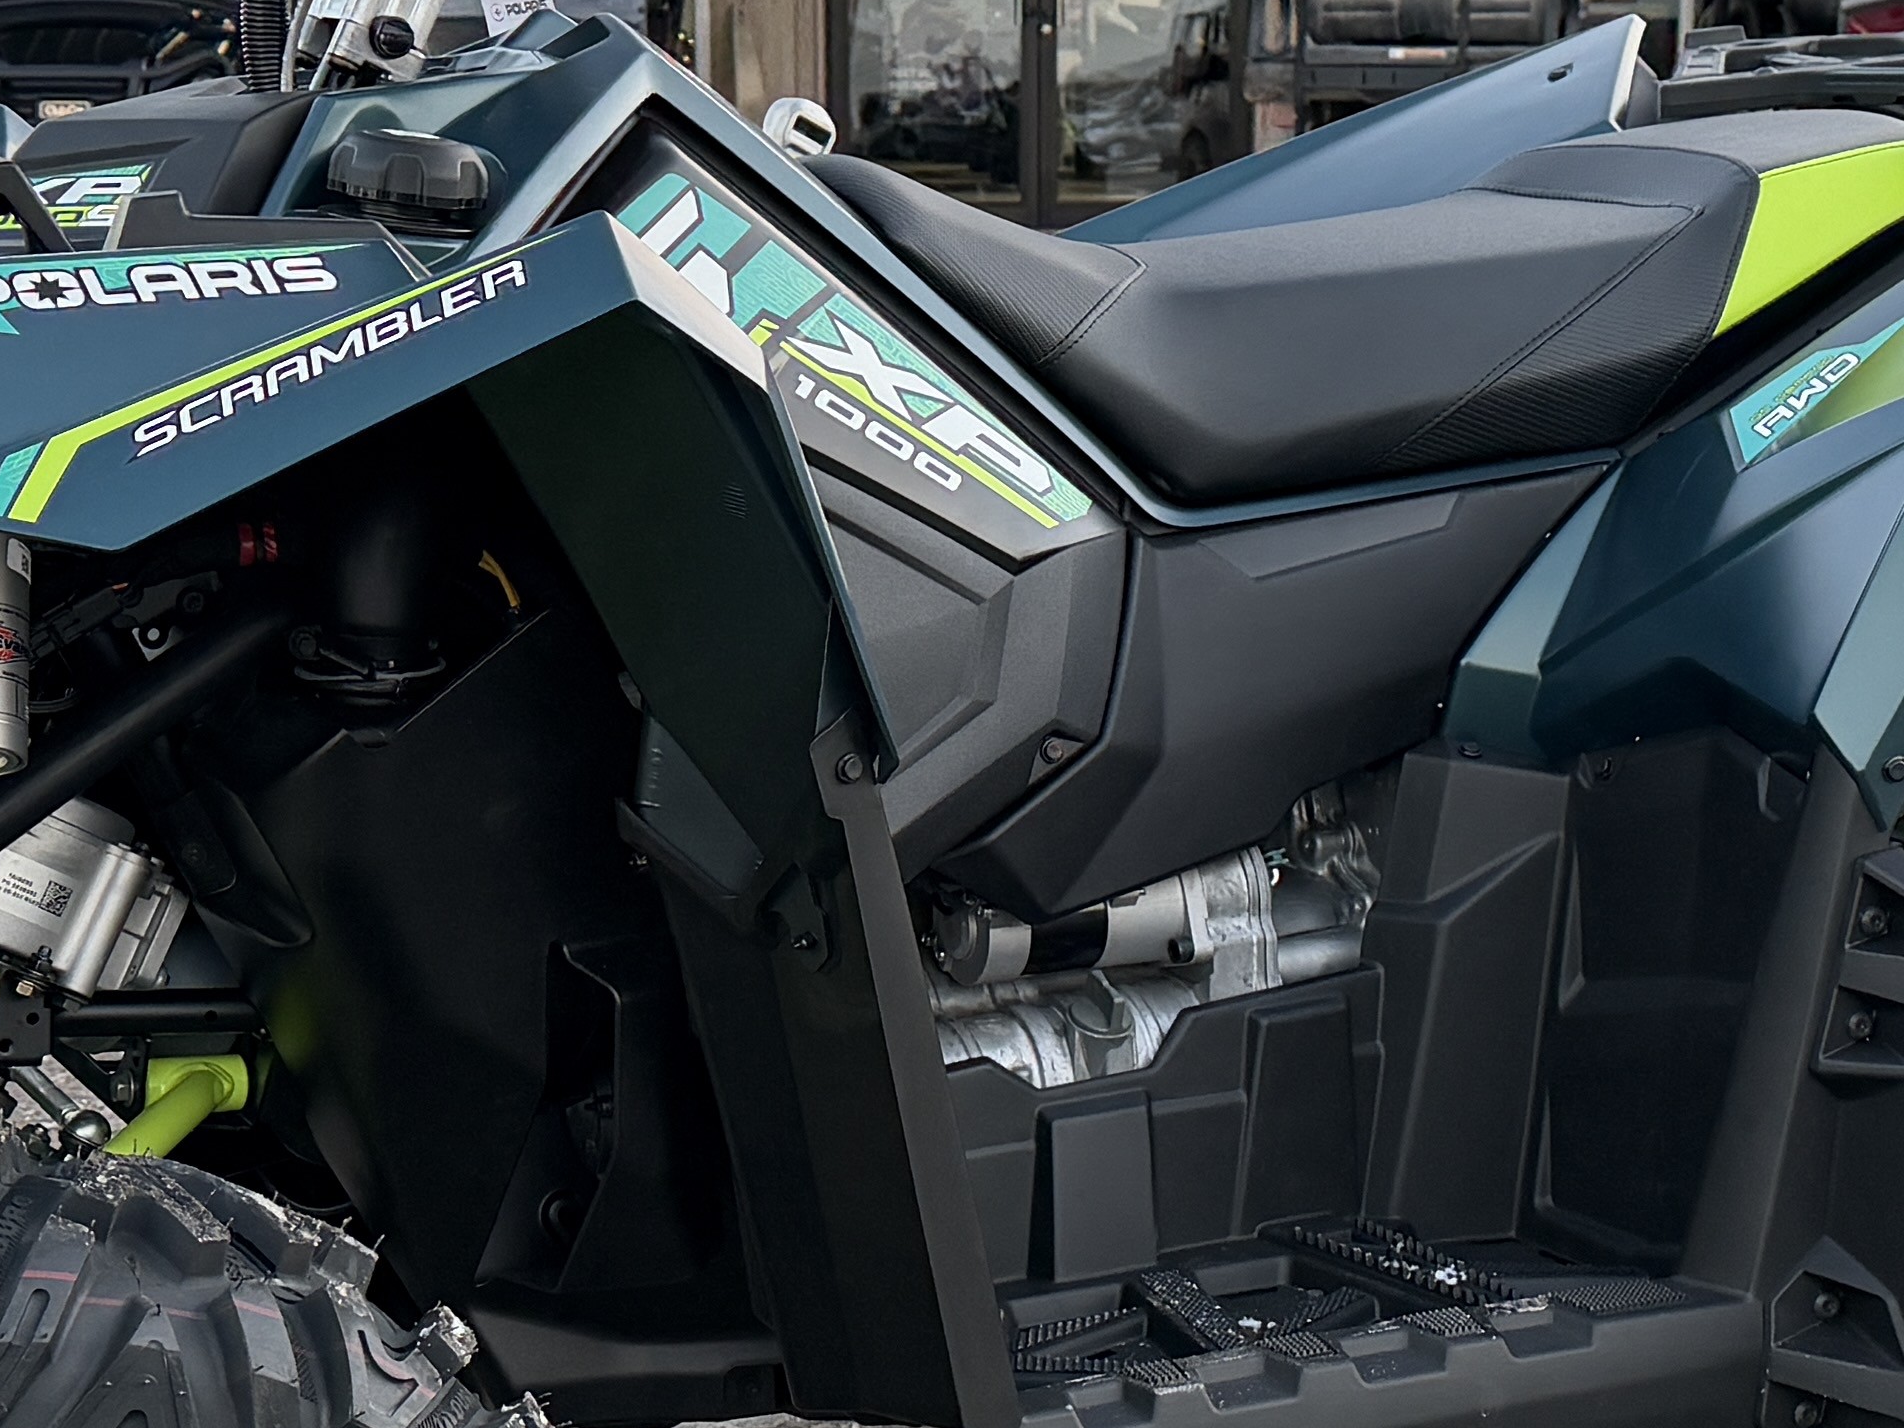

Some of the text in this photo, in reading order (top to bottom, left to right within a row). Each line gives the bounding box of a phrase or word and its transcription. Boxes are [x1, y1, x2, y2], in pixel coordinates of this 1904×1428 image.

[129, 257, 528, 462] SCRAMBLER
[1751, 351, 1862, 440] AWD
[793, 373, 963, 493] 1000
